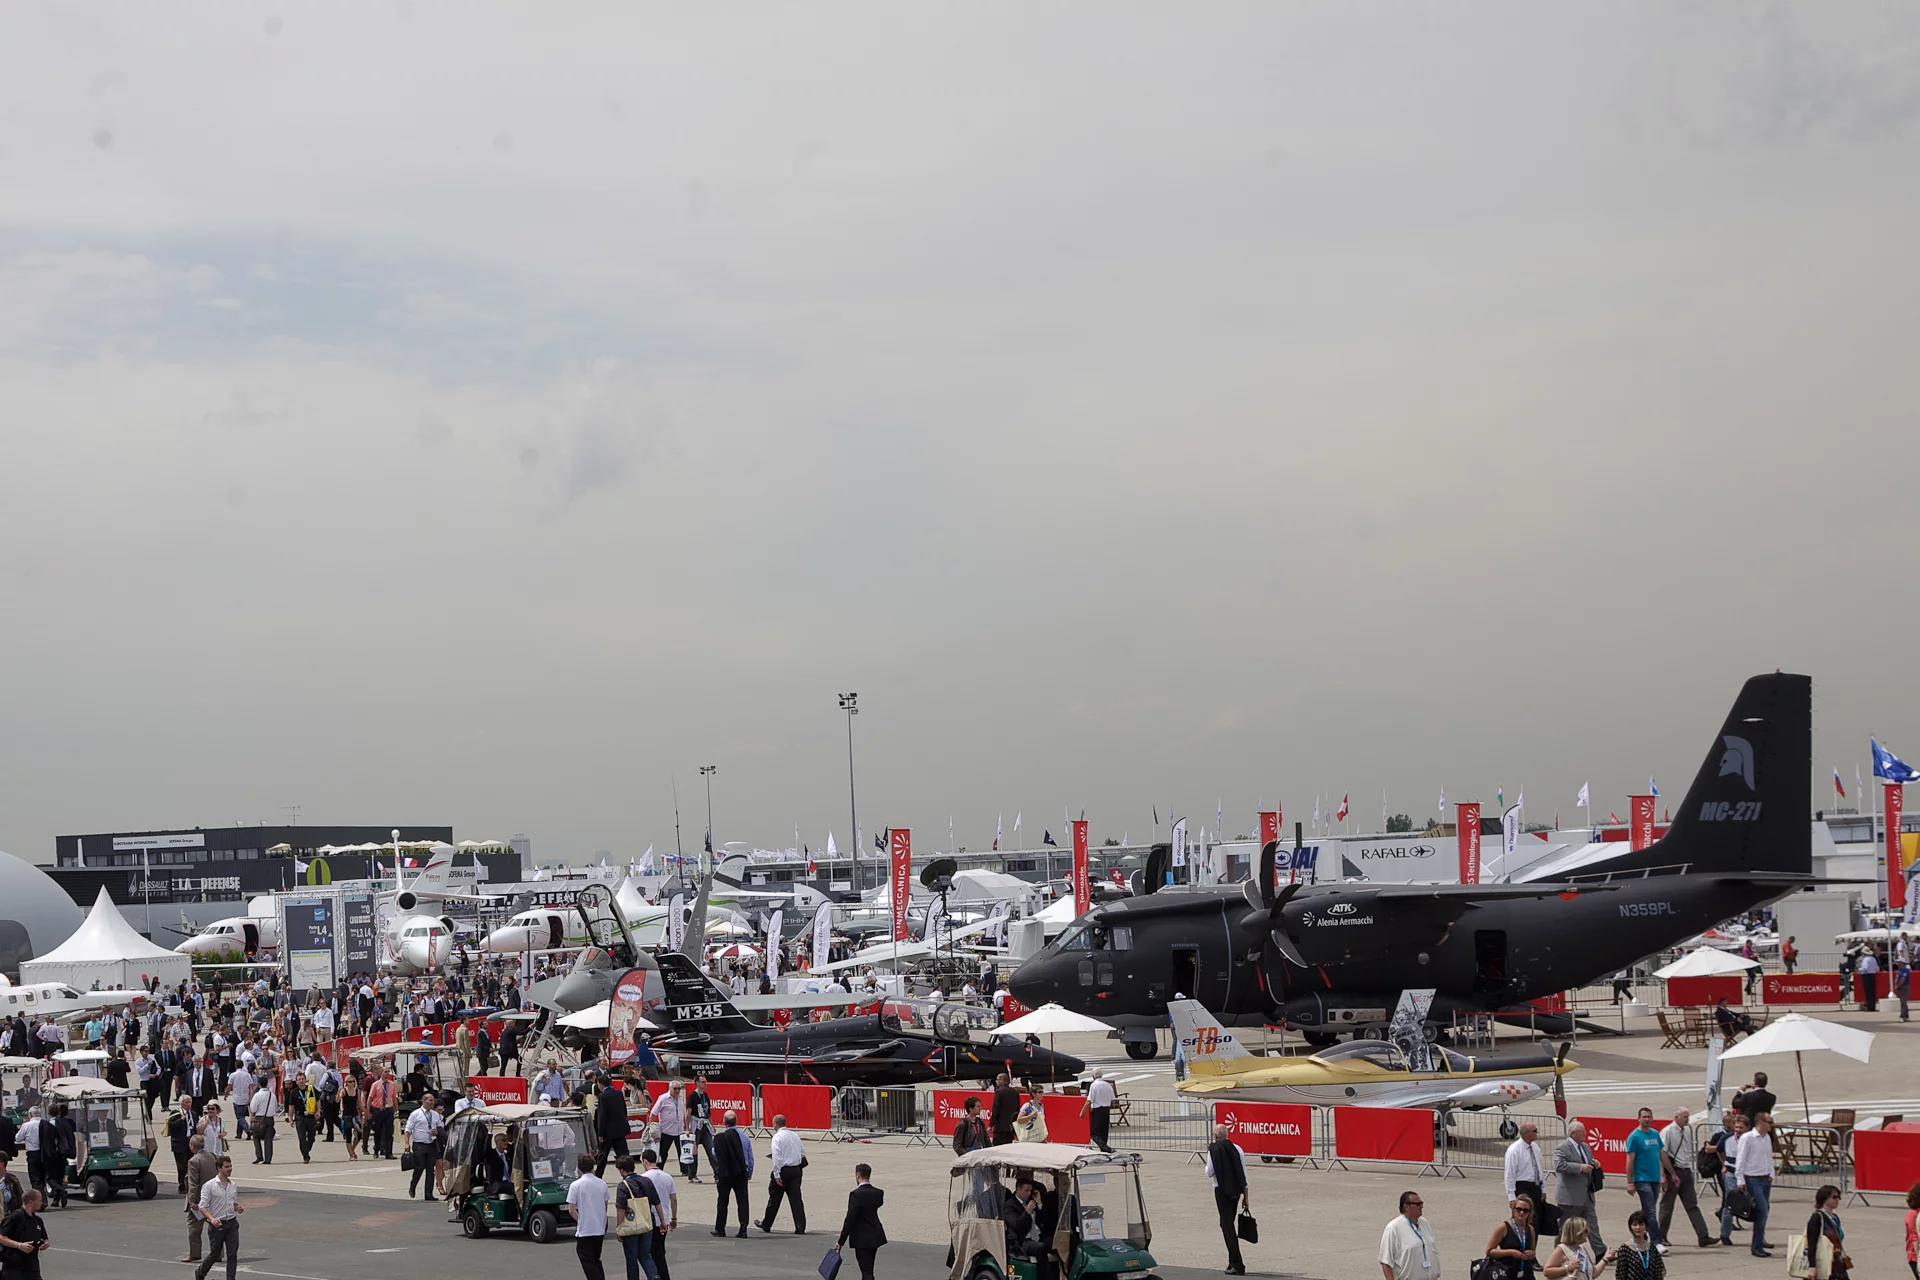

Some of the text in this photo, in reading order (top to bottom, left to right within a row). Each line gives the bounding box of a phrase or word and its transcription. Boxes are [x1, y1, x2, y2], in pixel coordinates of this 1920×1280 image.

[1700, 802, 1762, 821] MC-27J
[1361, 848, 1410, 860] RAFAEL
[1467, 828, 1478, 876] Technologies
[179, 878, 192, 890] LA
[1332, 904, 1352, 912] ATK
[1619, 902, 1676, 917] N359PL
[1317, 916, 1374, 926] Alenia Aermacchi
[318, 925, 327, 935] L4
[483, 1092, 521, 1102] FINMECCANICA
[1239, 1122, 1301, 1135] FINMECCANICA
